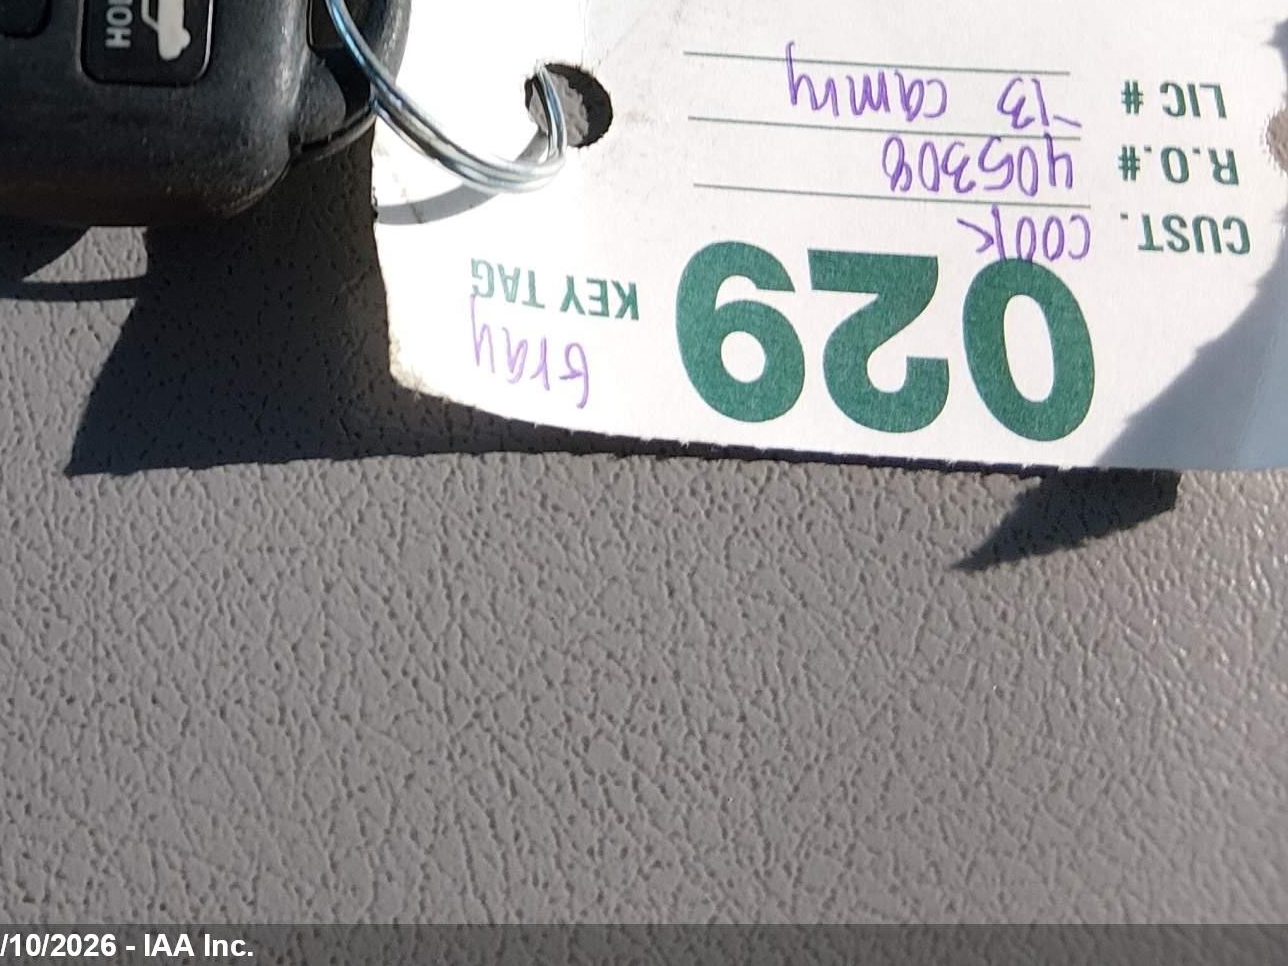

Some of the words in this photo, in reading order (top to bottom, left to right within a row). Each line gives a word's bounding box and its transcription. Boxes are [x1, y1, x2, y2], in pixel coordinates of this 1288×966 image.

[1120, 80, 1144, 115] #
[1159, 81, 1228, 119] LIC
[882, 131, 1073, 197] 405308
[1118, 144, 1240, 187] R.O.#
[1119, 213, 1251, 255] CUST.
[469, 258, 546, 306] TAG
[559, 274, 640, 321] KEY
[675, 240, 1095, 441] 029
